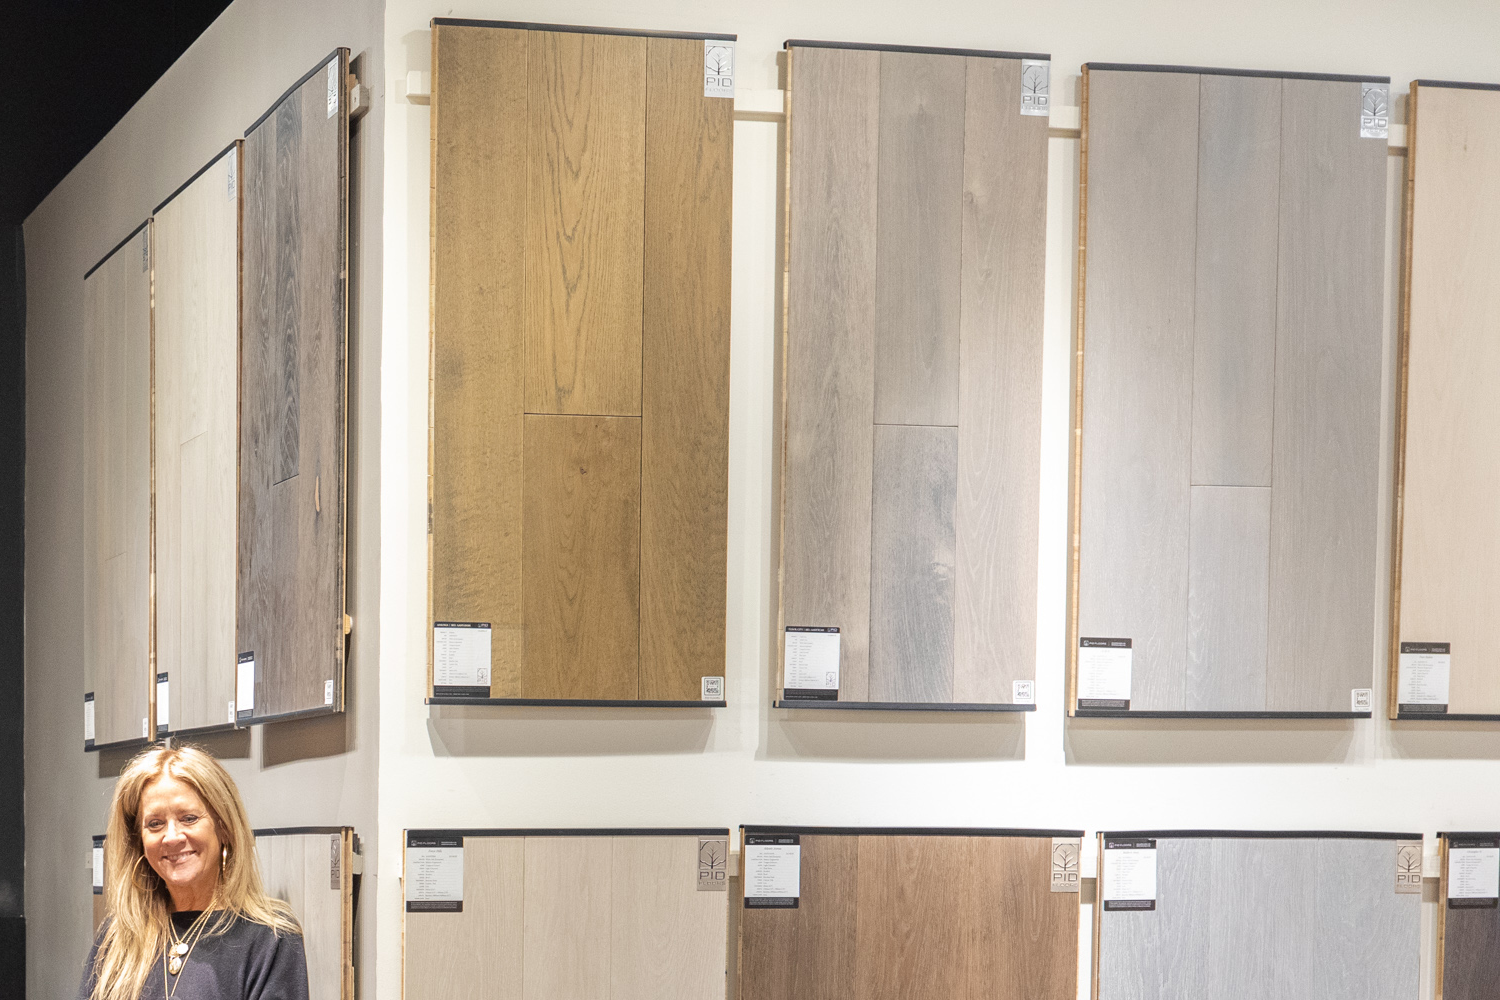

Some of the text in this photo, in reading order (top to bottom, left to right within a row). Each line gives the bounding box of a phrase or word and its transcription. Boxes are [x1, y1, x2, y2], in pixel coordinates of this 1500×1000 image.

[706, 77, 732, 87] PID
[1022, 96, 1047, 105] PID
[1363, 118, 1386, 127] PID
[700, 871, 725, 880] PID
[1053, 873, 1077, 881] PID
[1397, 874, 1420, 883] PID
